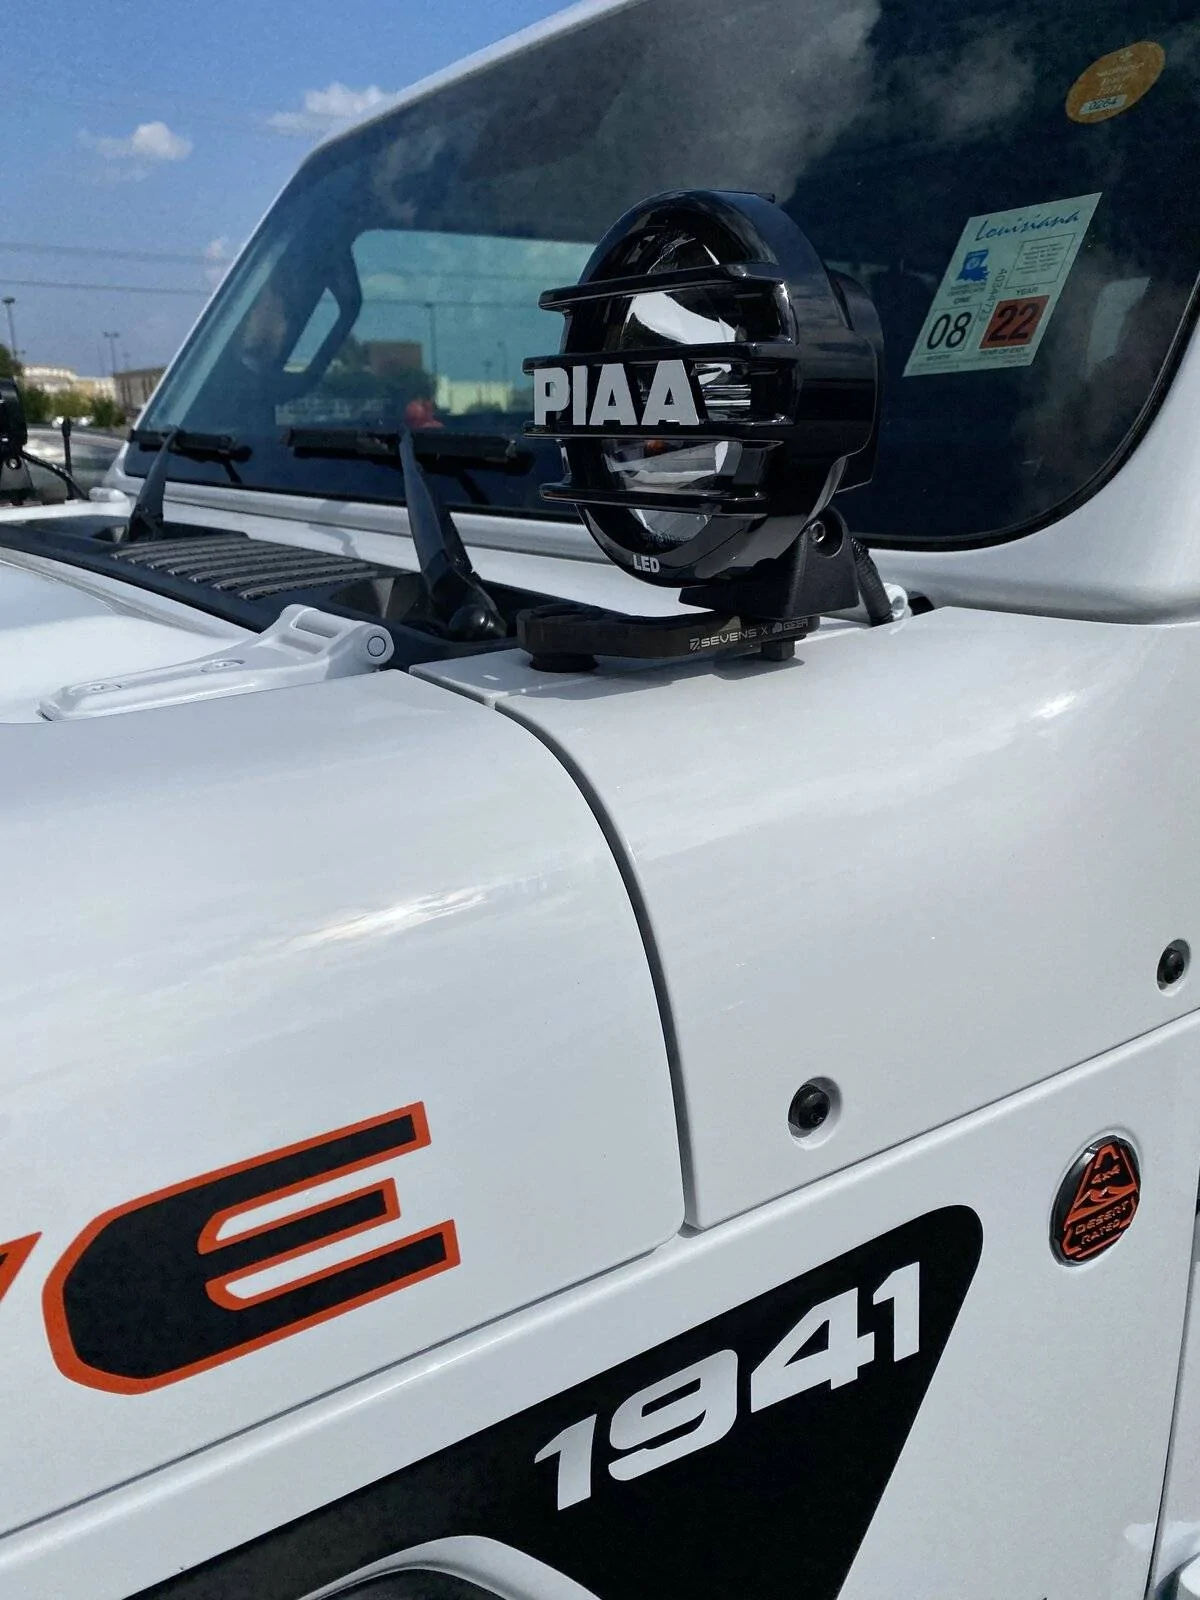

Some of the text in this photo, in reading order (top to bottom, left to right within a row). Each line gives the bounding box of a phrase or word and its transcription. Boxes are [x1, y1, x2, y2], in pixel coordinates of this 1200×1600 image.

[973, 209, 1081, 242] Louisiana
[926, 311, 973, 350] 08
[987, 302, 1039, 342] 22
[533, 359, 700, 426] PIAA
[632, 554, 660, 574] LED
[1075, 1200, 1129, 1235] DESERT
[1081, 1218, 1121, 1245] RATED
[534, 1261, 920, 1512] 1941
